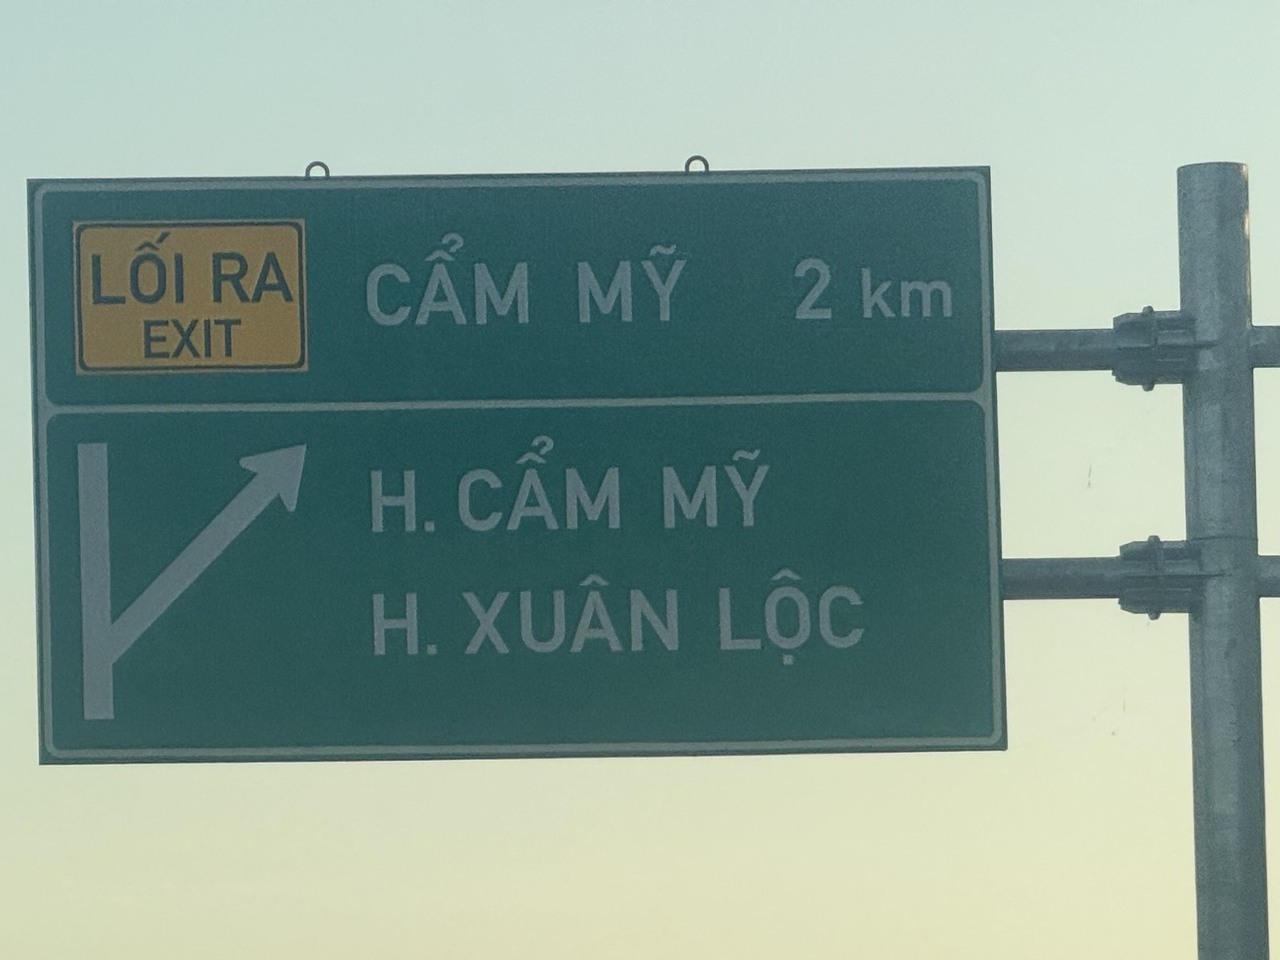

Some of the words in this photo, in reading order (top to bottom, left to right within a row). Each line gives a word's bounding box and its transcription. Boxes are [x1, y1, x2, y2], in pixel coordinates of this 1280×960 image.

[92, 232, 184, 305] LỐI
[213, 252, 293, 304] RA
[366, 233, 530, 326] CẨM
[577, 245, 687, 322] MỸ
[794, 258, 833, 319] 2
[861, 268, 953, 317] km
[144, 319, 242, 359] EXIT
[371, 469, 436, 532] H.
[458, 435, 621, 531] CẨM
[662, 449, 770, 528] MỸ
[373, 593, 438, 656] H.
[464, 574, 679, 654] XUÂN
[719, 569, 865, 665] LỘC
